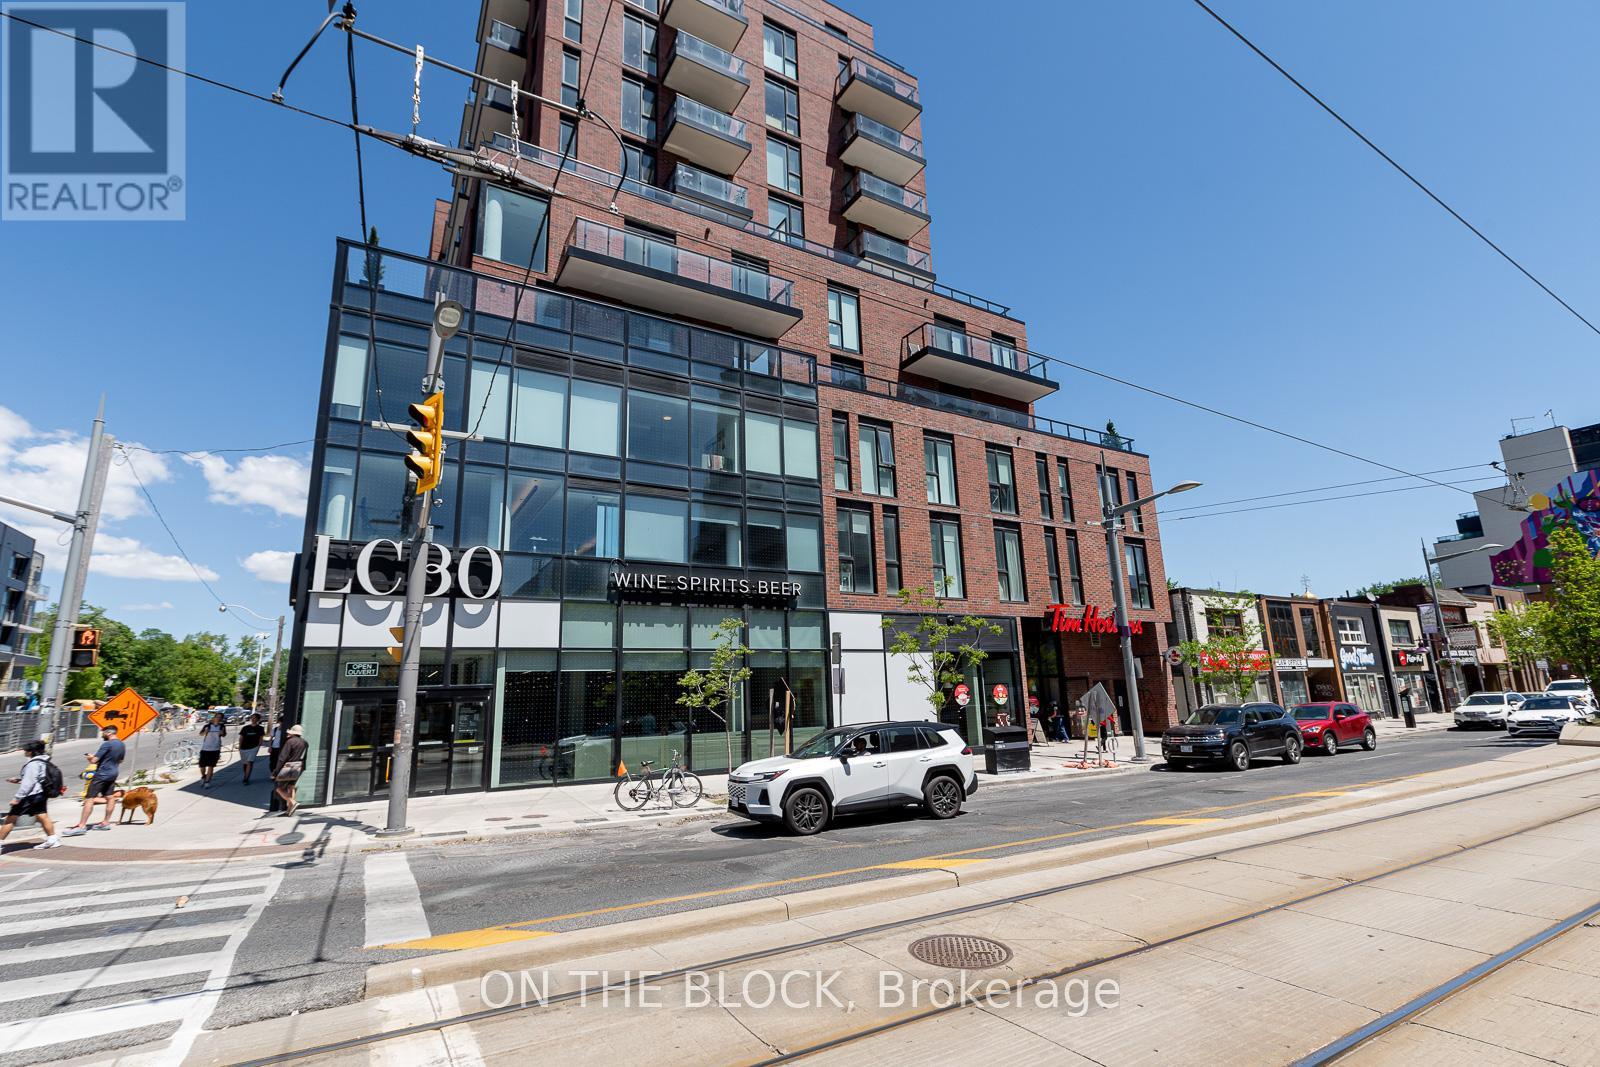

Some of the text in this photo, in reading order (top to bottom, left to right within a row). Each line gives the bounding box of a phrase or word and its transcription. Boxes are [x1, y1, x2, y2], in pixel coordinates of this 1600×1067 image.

[614, 572, 802, 596] WINE SPIRITS BEER
[1047, 604, 1082, 633] Tim
